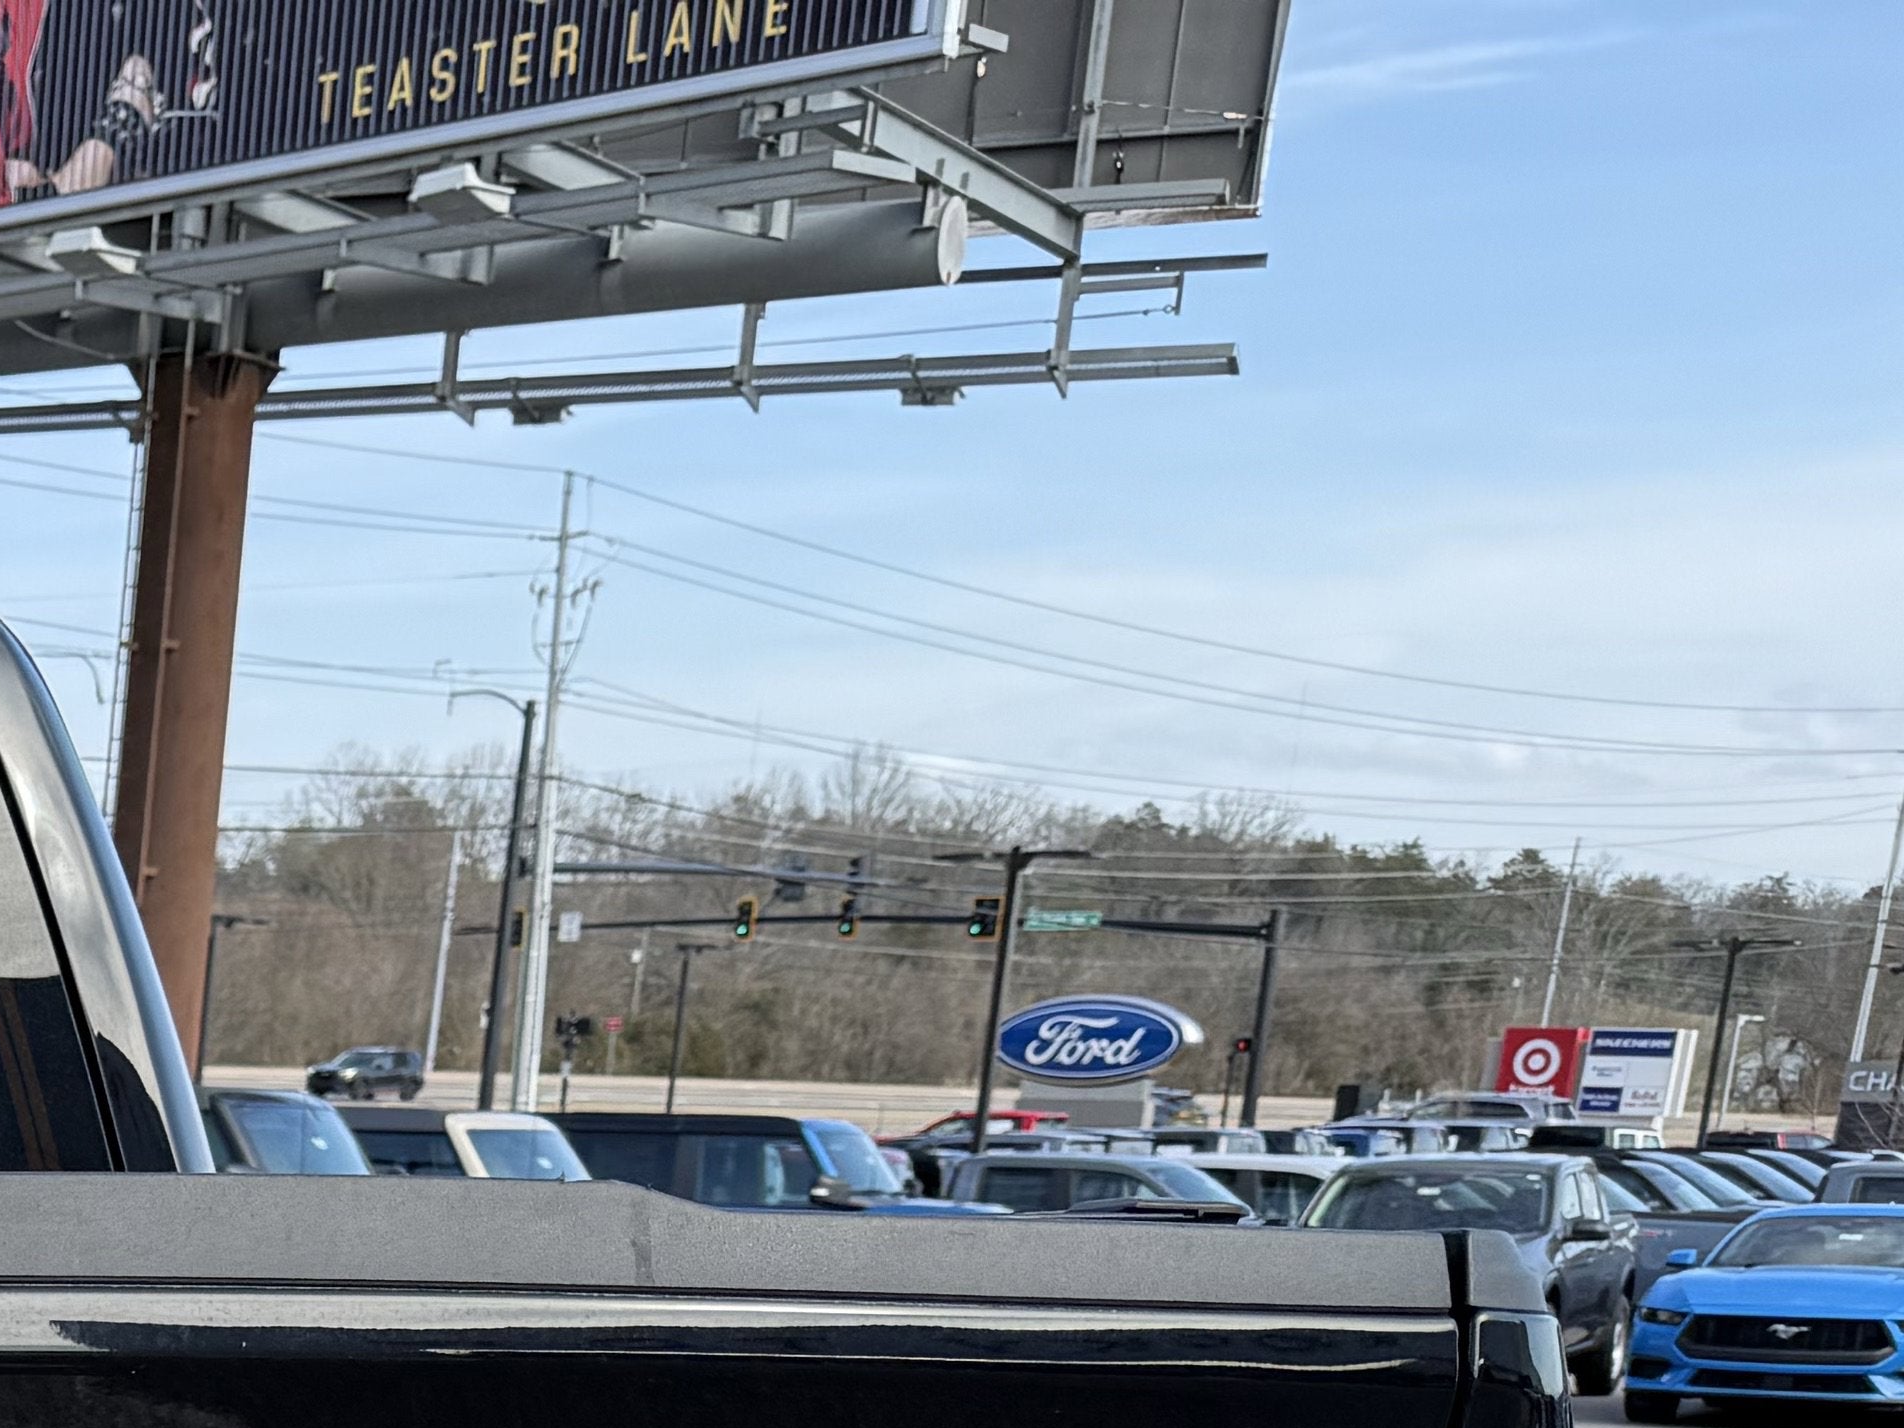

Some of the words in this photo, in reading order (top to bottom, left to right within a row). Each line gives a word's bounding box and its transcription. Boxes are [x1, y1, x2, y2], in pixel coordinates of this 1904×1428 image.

[318, 23, 580, 124] TEASTER
[626, 0, 789, 64] LANE
[1024, 1014, 1147, 1066] Ford
